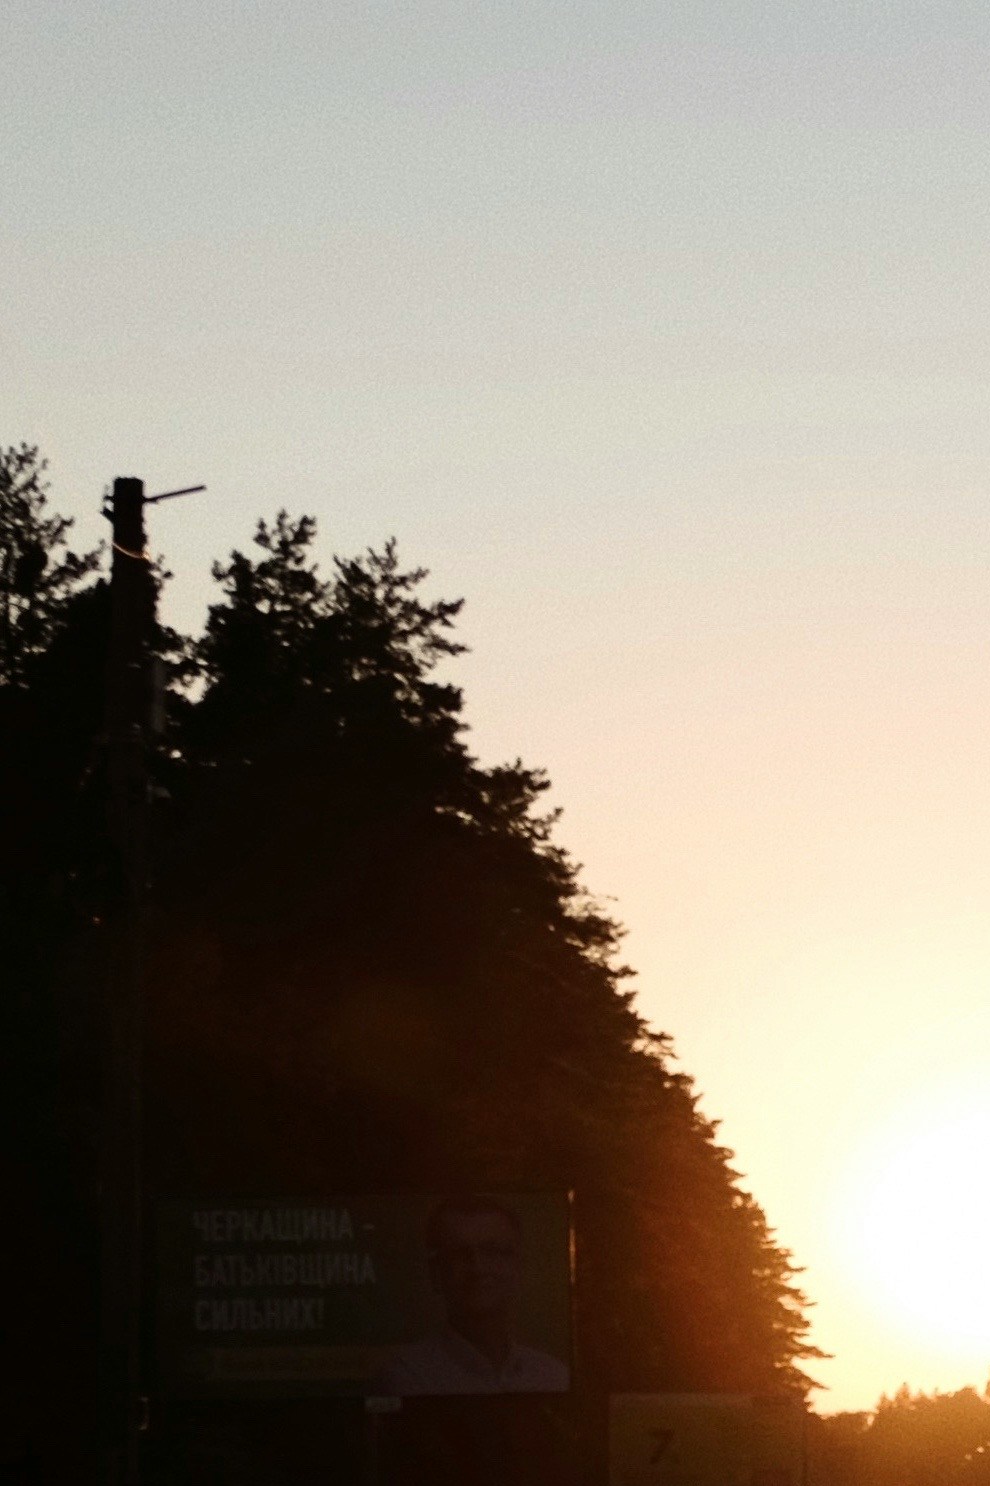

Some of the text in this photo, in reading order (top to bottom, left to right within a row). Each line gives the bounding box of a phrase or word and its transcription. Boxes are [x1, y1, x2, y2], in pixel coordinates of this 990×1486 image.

[194, 1208, 353, 1243] ЧЕРКАЩИНА
[194, 1254, 375, 1287] БАТЬКІВЩИНА
[195, 1299, 324, 1332] СИЛЬНИХ!
